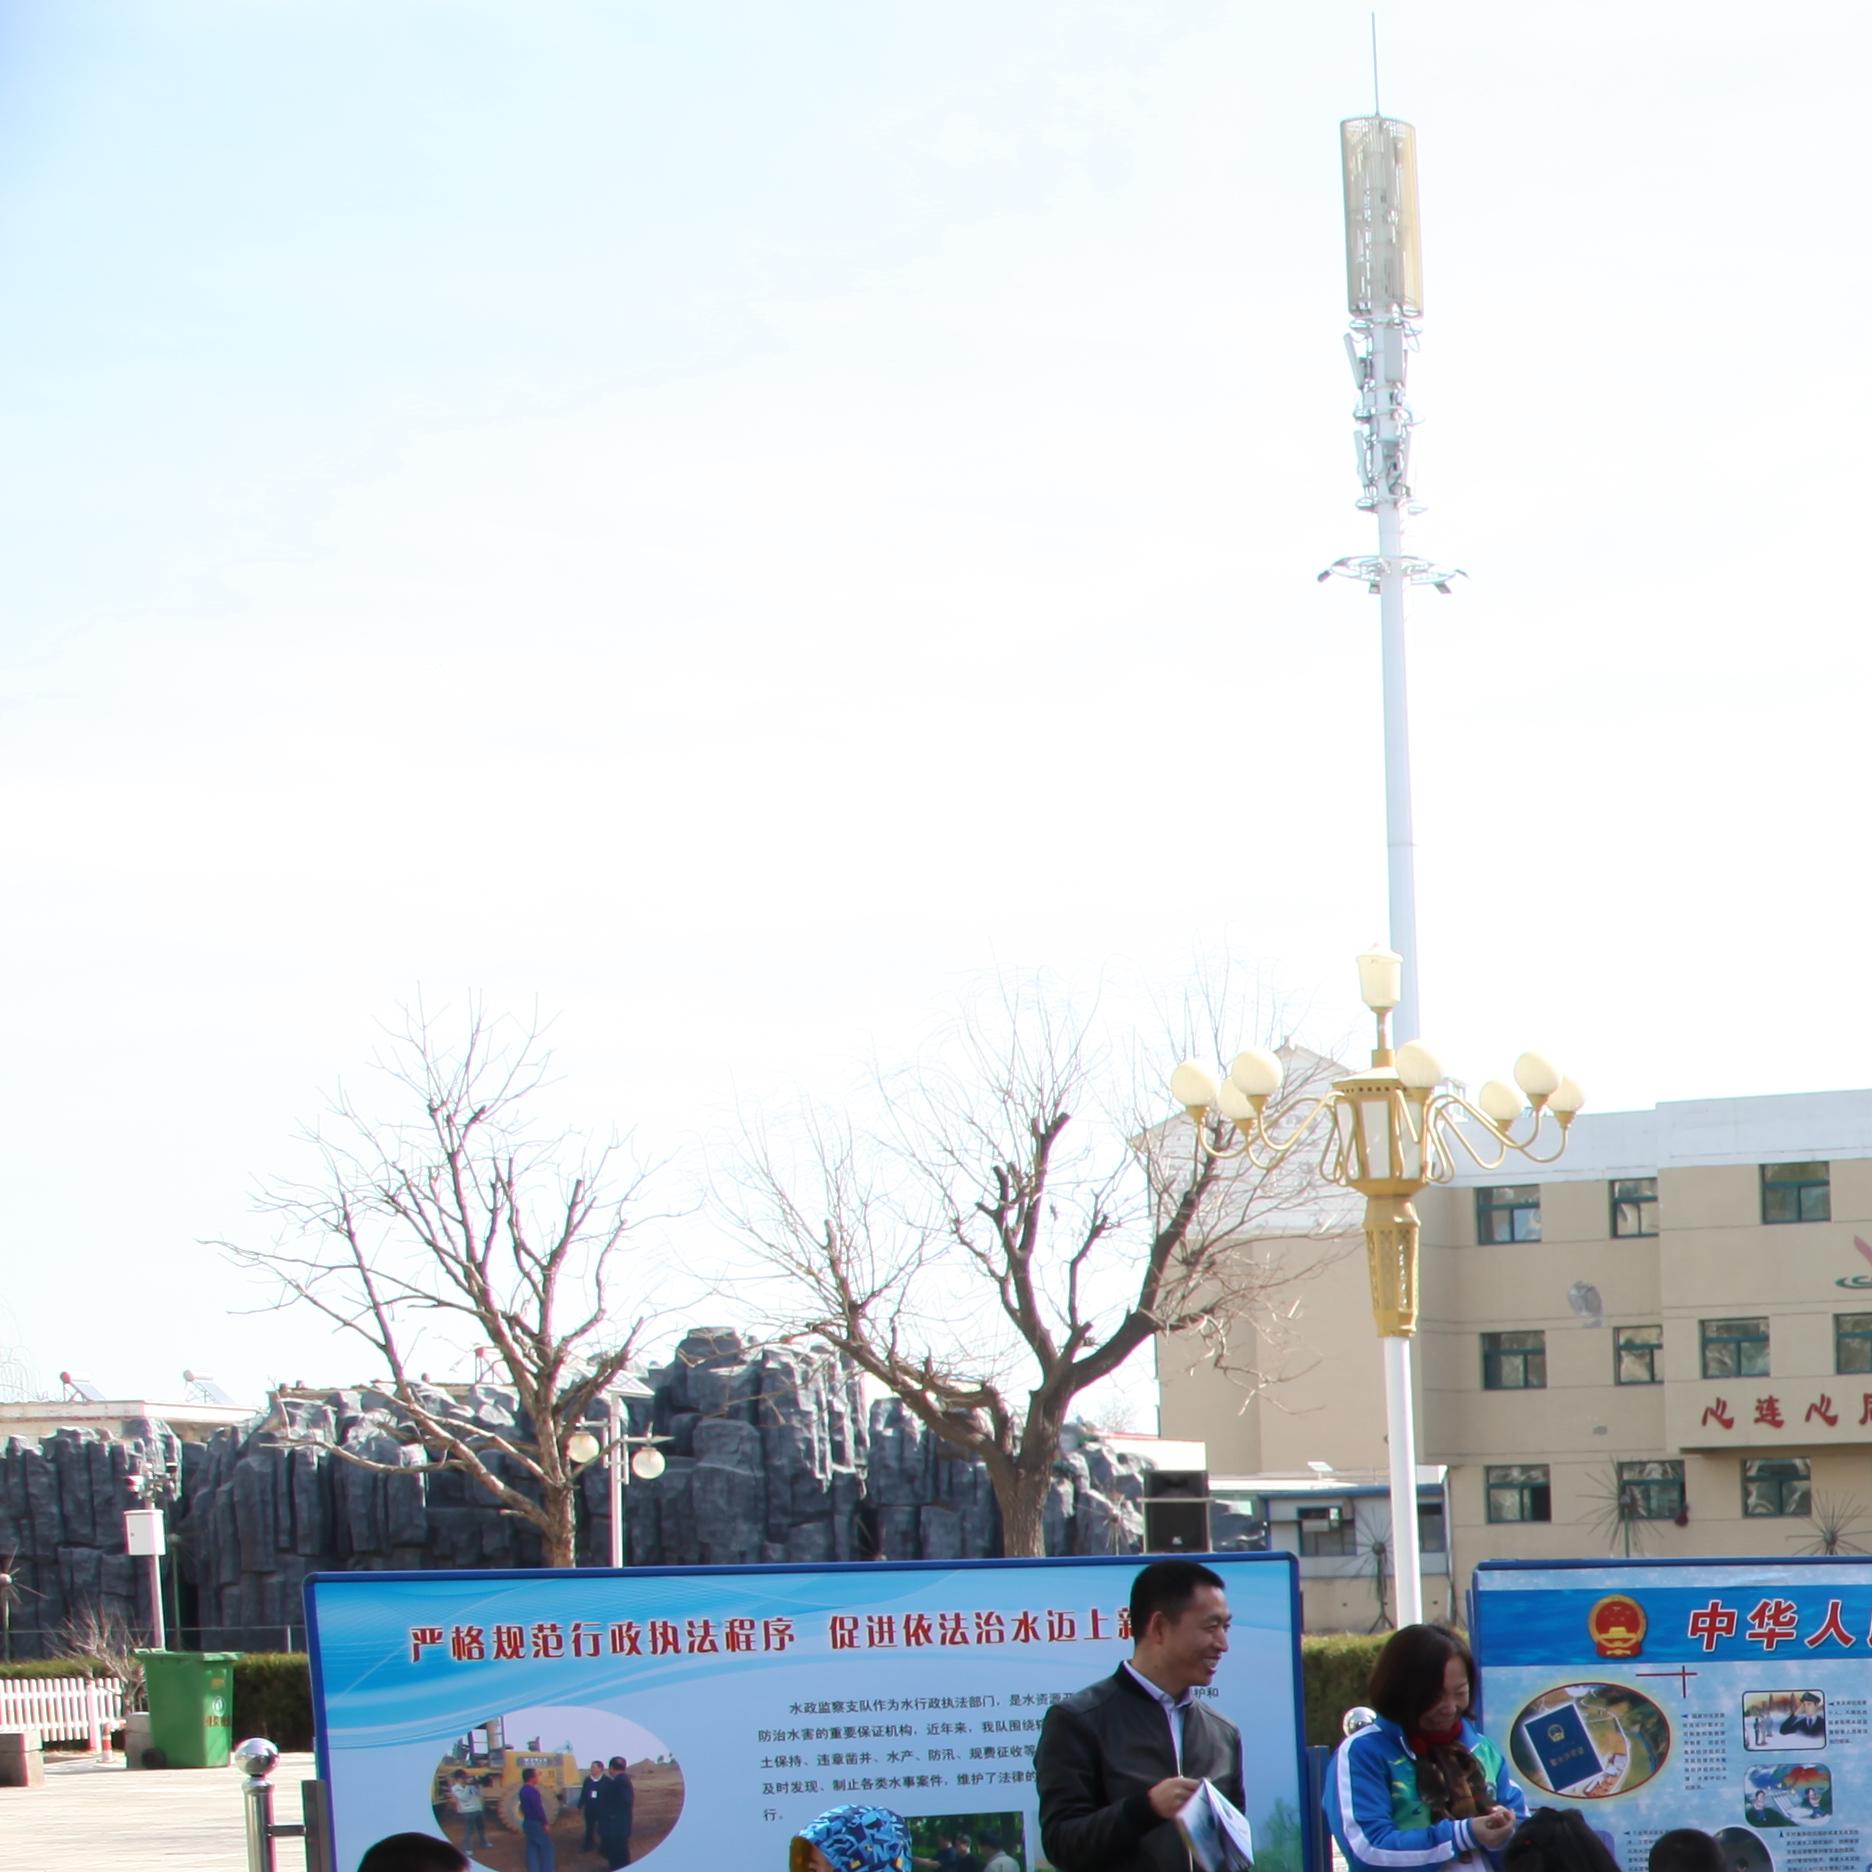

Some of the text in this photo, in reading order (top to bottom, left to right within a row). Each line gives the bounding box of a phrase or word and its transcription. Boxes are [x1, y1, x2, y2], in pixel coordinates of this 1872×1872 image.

[409, 1615, 797, 1664] 严格规范行政执法程序
[764, 1807, 784, 1822] 行。
